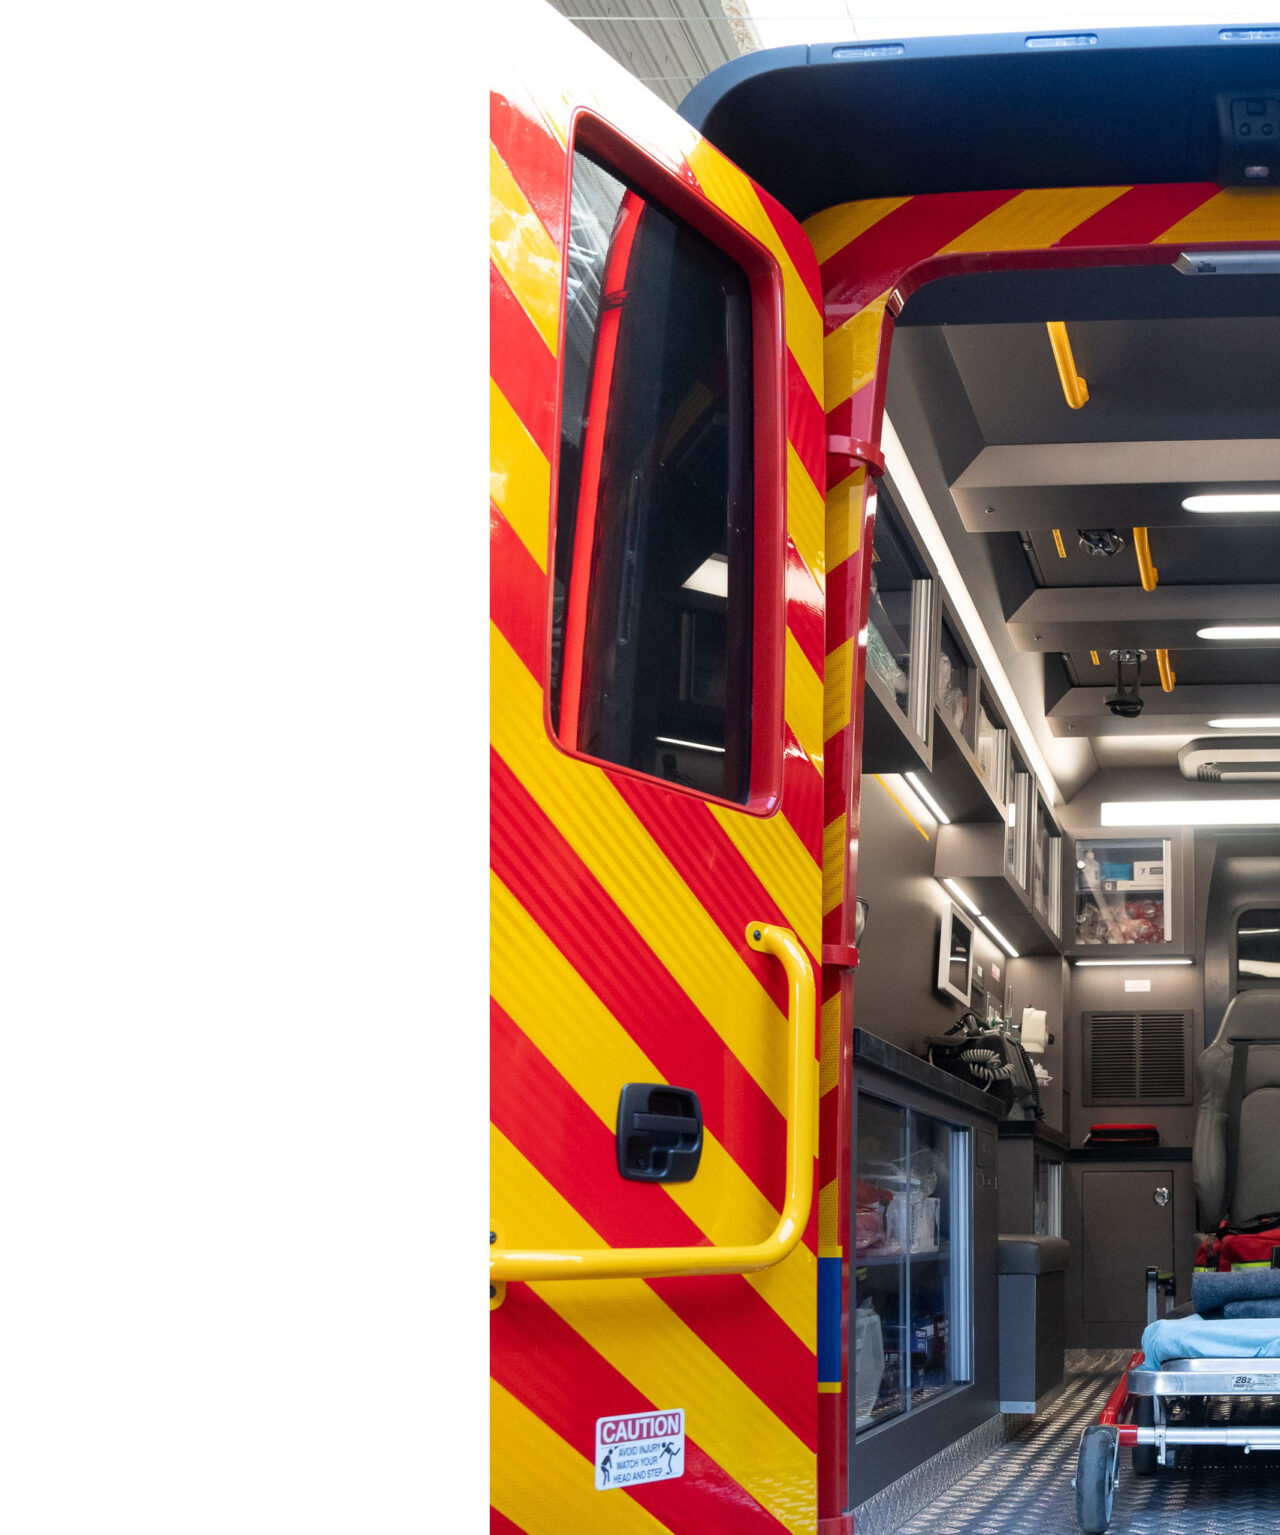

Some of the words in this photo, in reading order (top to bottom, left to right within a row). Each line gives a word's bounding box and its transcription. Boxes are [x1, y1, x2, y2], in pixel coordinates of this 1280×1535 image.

[602, 1414, 679, 1443] CAUTION
[618, 1446, 637, 1457] AVOID
[640, 1443, 661, 1454] INJURY
[616, 1459, 639, 1470] WATCH
[640, 1456, 658, 1466] YOUR
[613, 1472, 632, 1484] HEAD
[632, 1470, 647, 1480] AND
[647, 1467, 663, 1478] STEP
